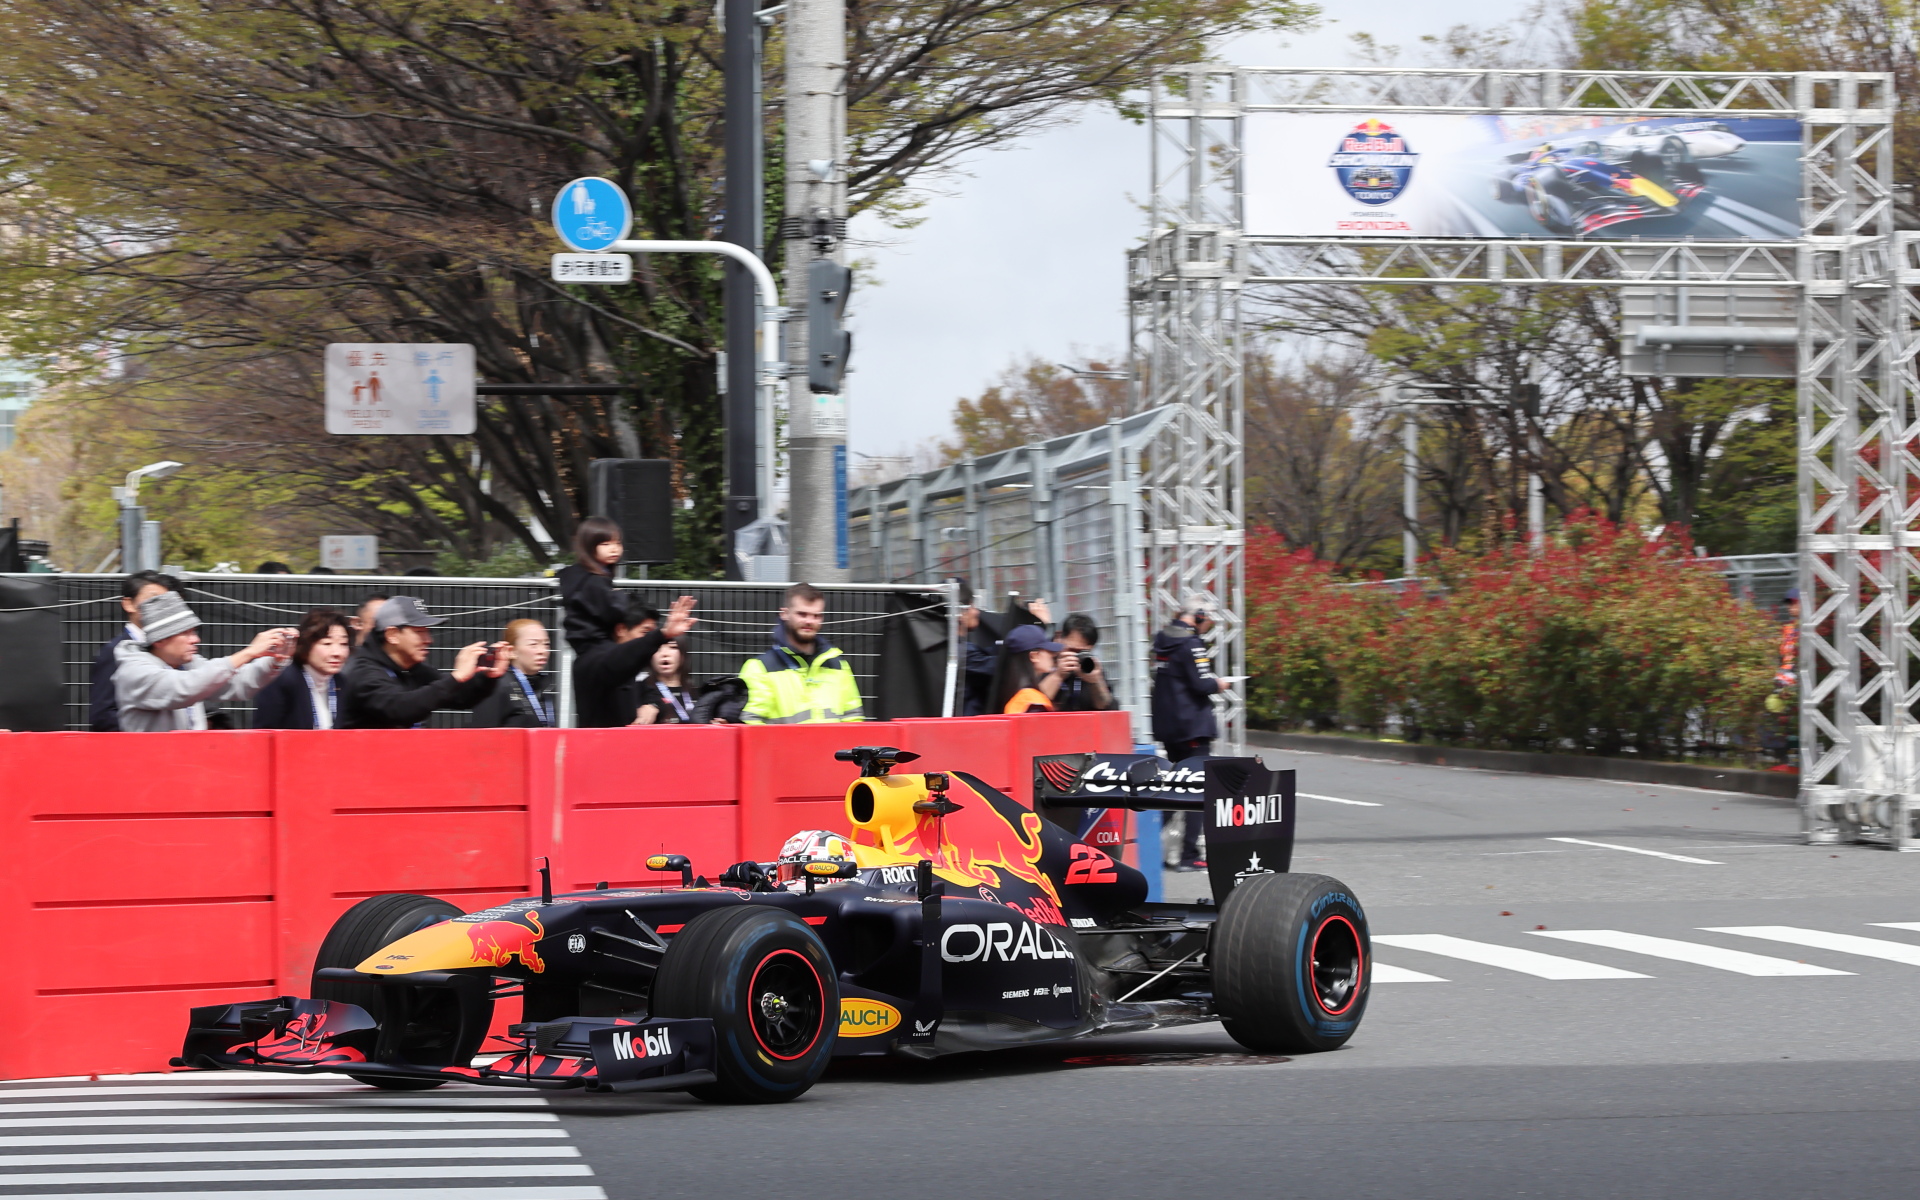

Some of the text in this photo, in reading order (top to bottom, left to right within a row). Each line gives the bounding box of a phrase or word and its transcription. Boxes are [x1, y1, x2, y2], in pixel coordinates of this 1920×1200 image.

[1336, 221, 1411, 230] HONDA
[1216, 796, 1265, 827] Mobil
[1096, 831, 1120, 844] COLA
[1064, 844, 1117, 885] 22
[881, 866, 917, 884] ROKT
[1070, 918, 1097, 928] HONDA
[1002, 989, 1030, 999] SIEMENS
[841, 1010, 889, 1025] AUCH
[613, 1027, 672, 1060] Mobil
